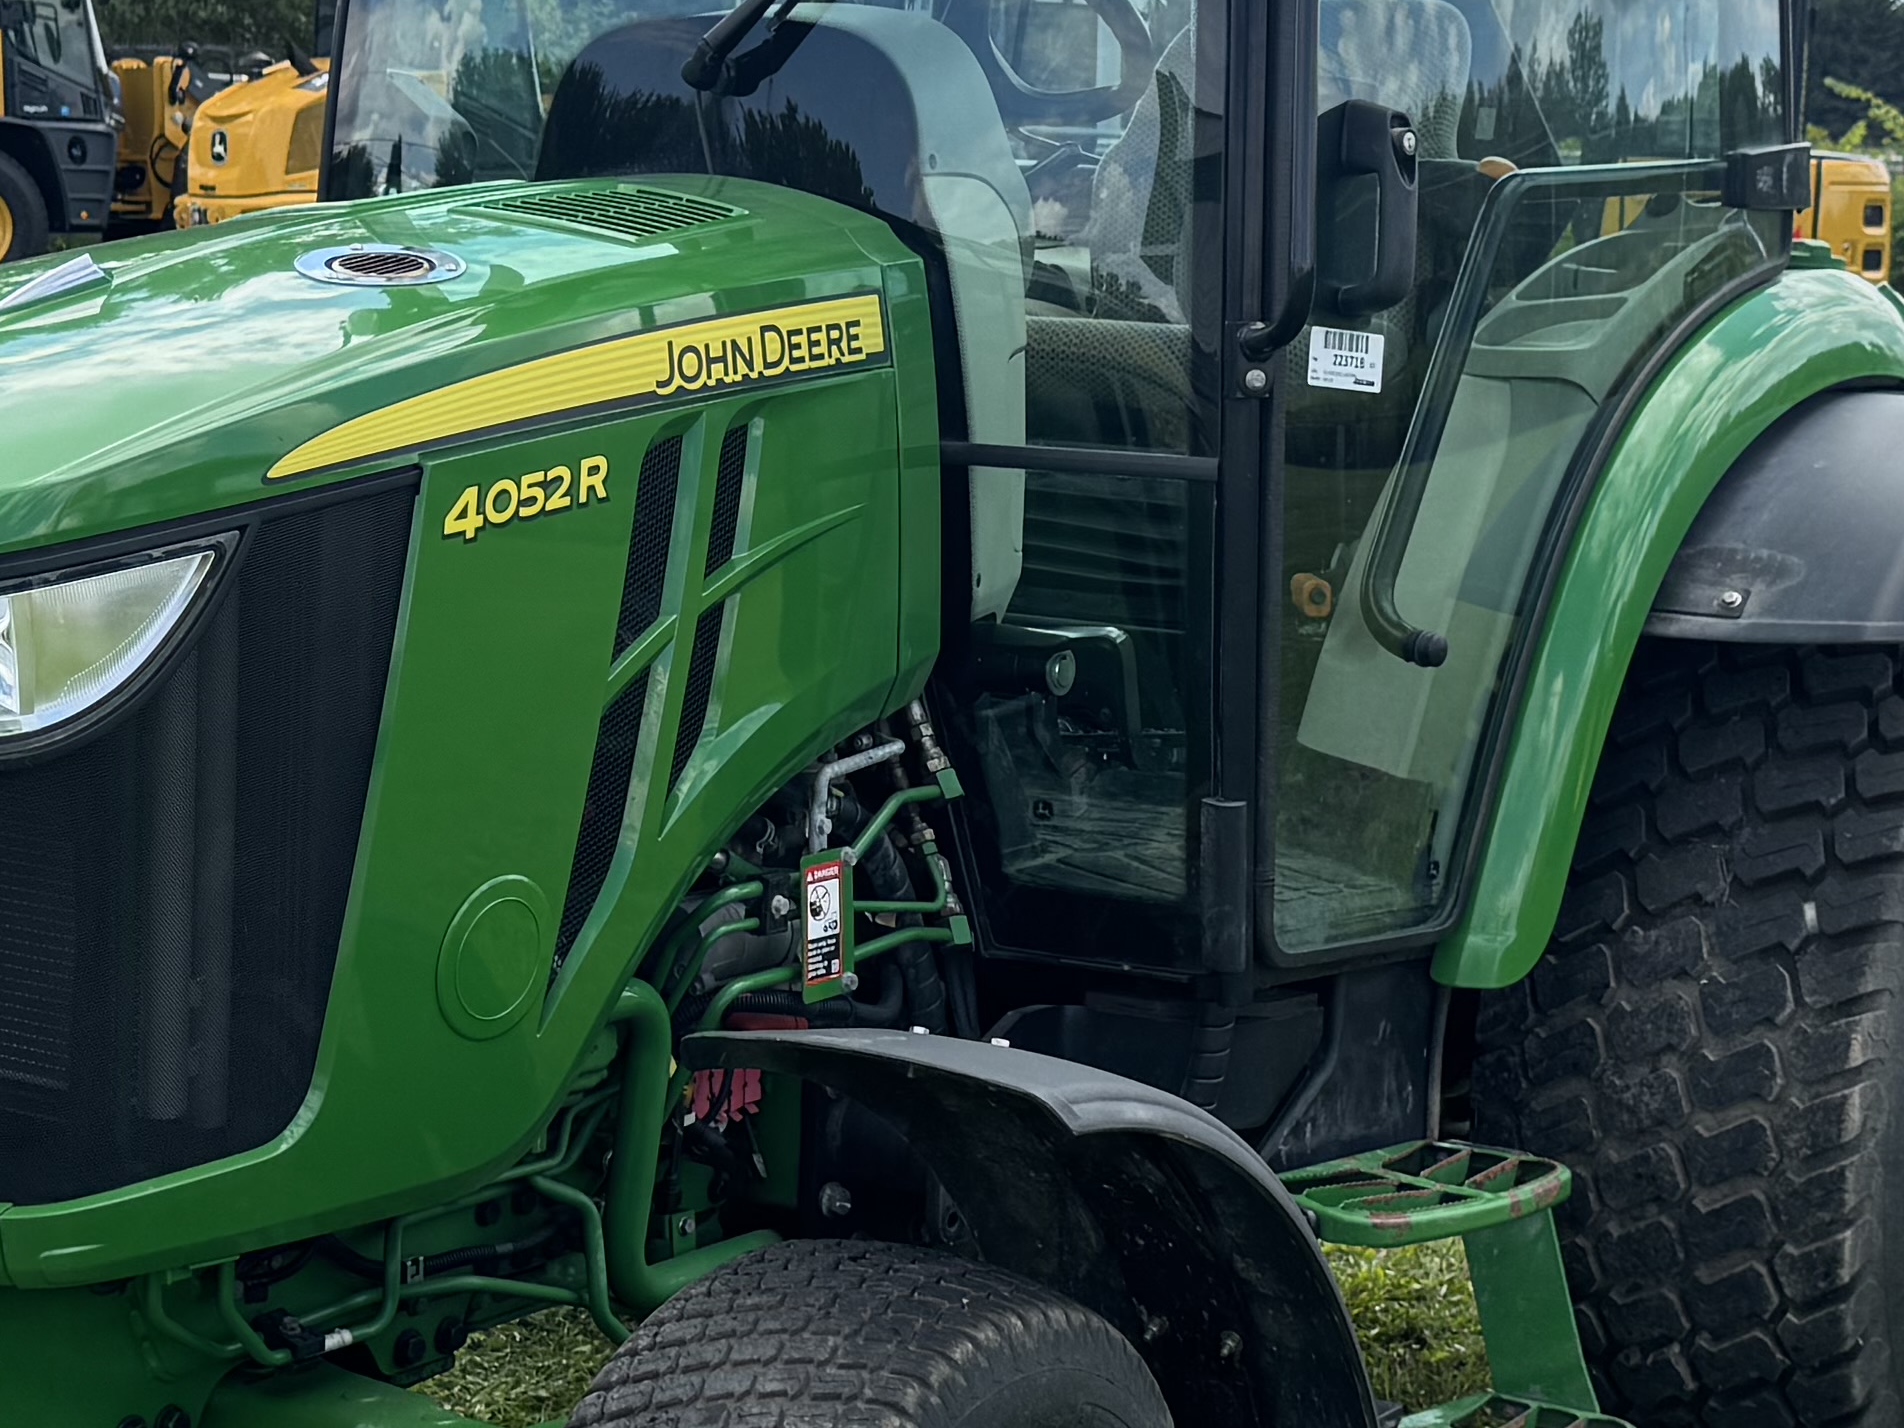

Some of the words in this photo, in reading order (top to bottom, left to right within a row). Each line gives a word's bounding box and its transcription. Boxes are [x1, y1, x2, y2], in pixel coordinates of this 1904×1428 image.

[655, 336, 756, 391] JOHN
[759, 319, 865, 373] DEERE
[443, 455, 609, 539] 4052R
